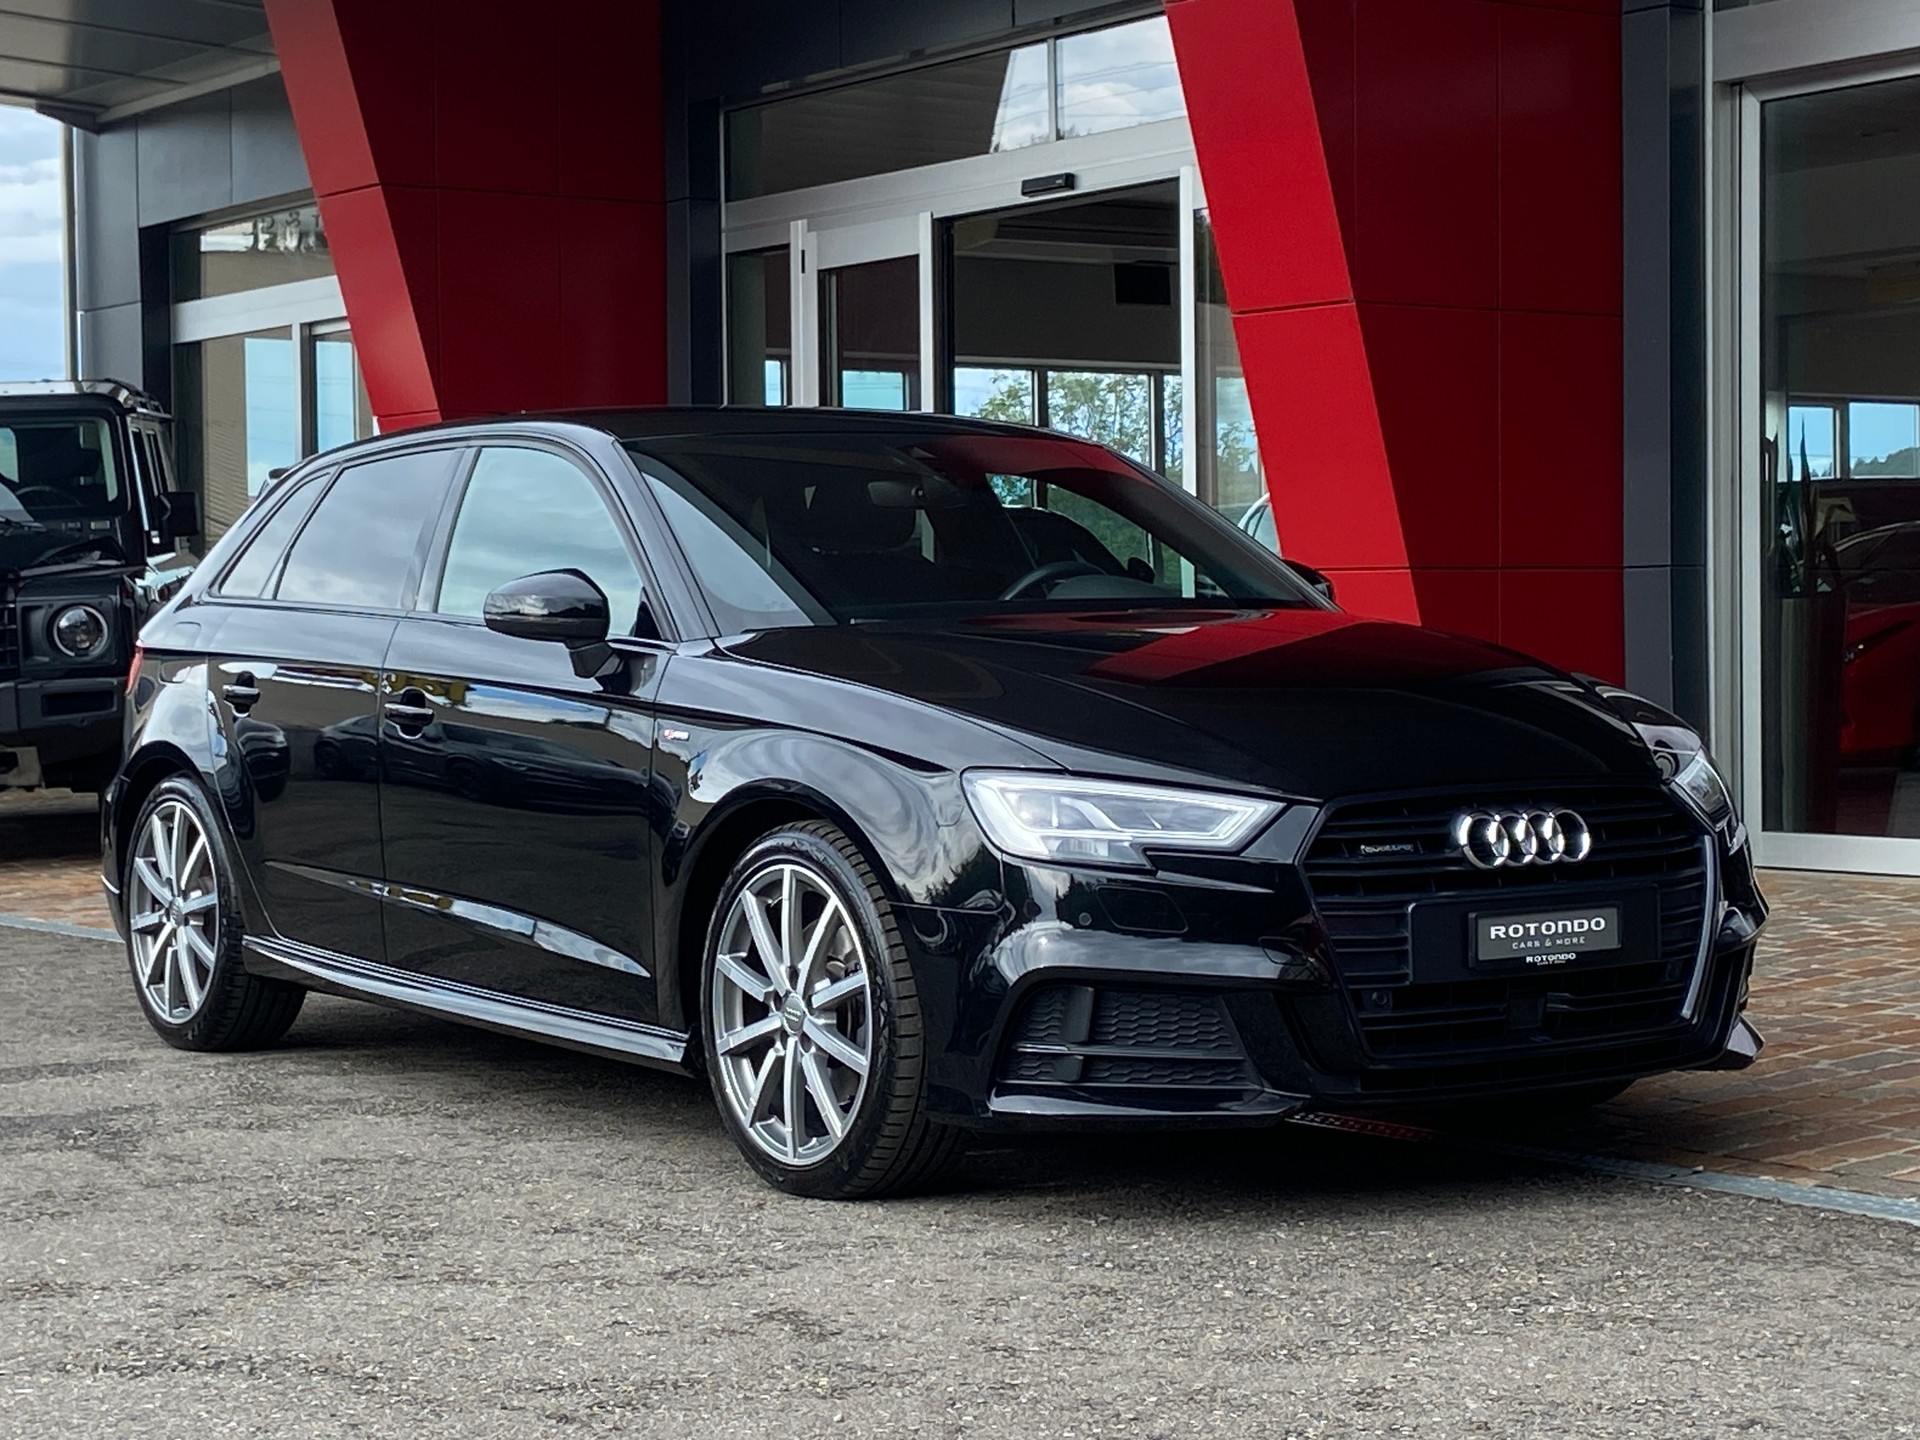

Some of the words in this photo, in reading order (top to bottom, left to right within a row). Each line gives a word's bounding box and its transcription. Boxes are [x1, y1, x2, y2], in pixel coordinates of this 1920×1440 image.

[1490, 917, 1606, 940] ROTONDO
[1512, 940, 1541, 950] CARS
[1556, 936, 1586, 947] MORE
[1526, 952, 1576, 963] ROTONDO
